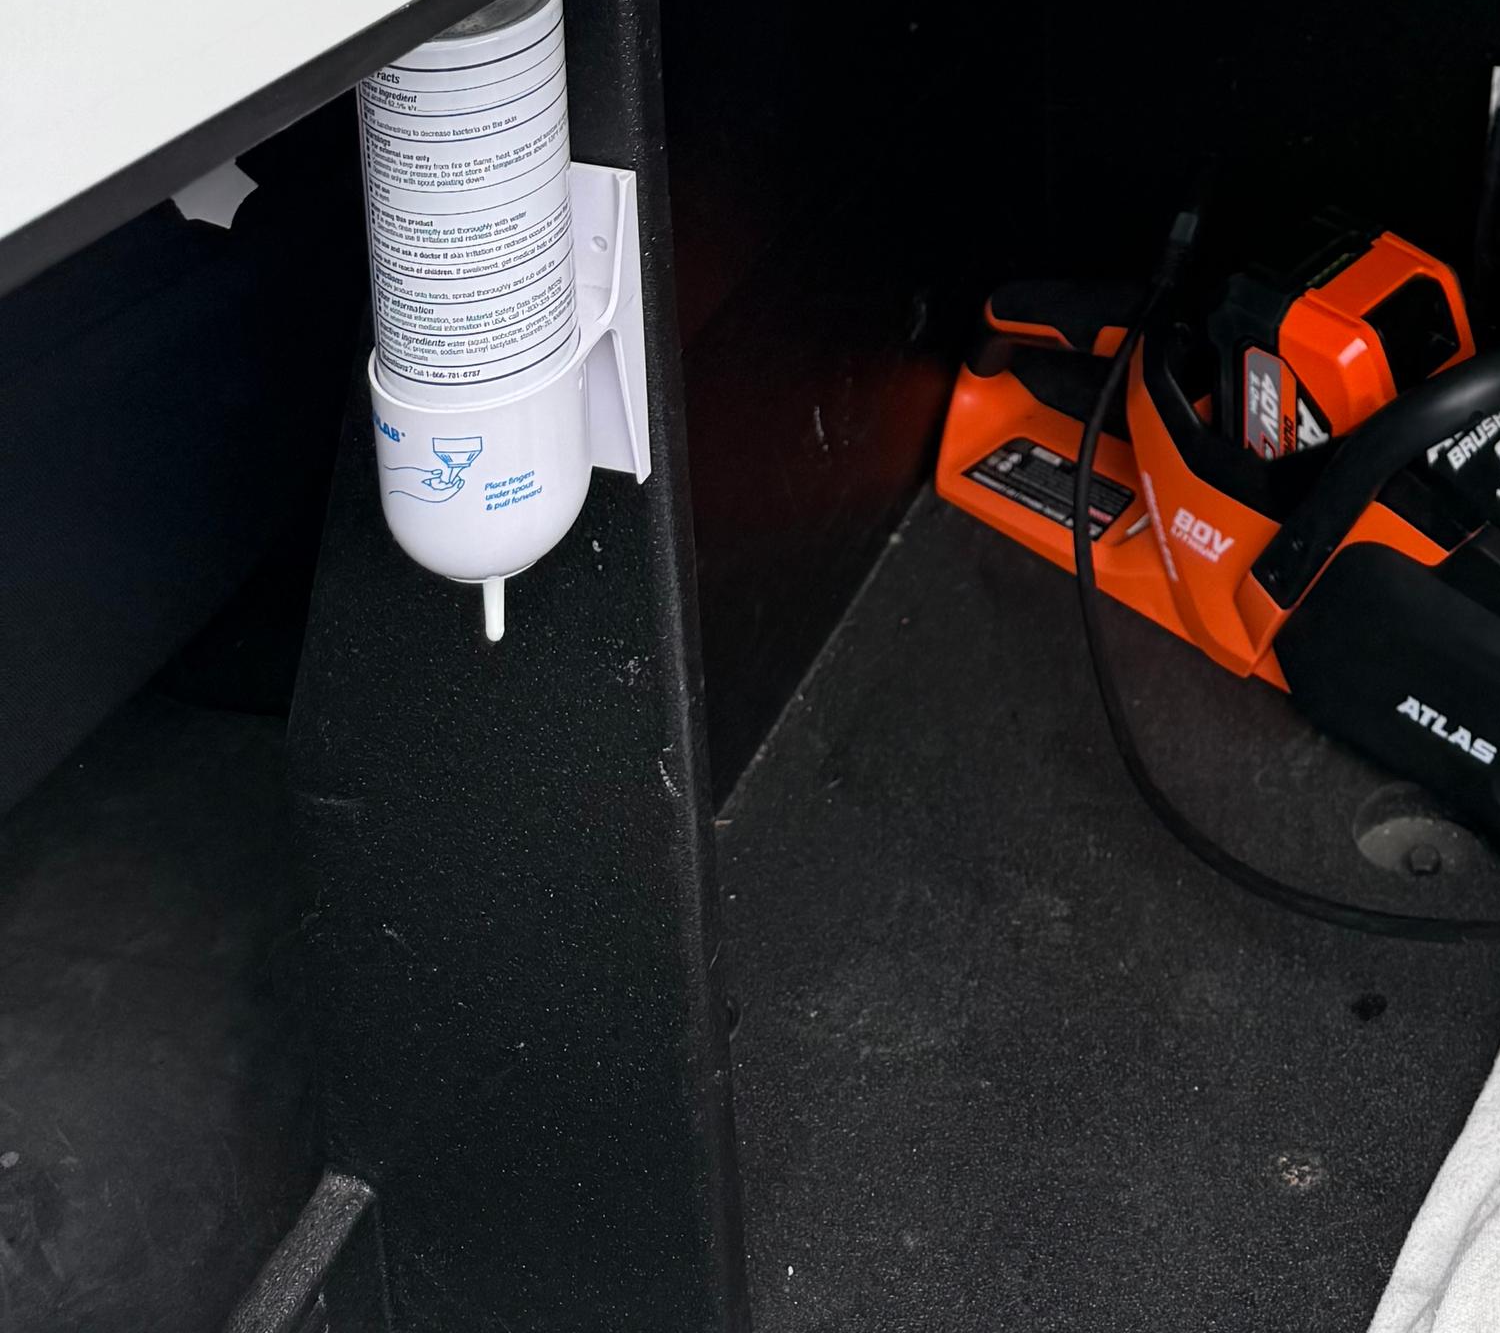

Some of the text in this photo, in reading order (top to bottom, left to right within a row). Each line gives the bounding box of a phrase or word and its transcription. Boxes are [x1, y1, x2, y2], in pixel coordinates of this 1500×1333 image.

[485, 470, 535, 491] Place fingers
[485, 481, 534, 501] under spout
[511, 486, 543, 503] forward
[1174, 507, 1235, 554] 80V
[1396, 695, 1498, 765] ATLAS
